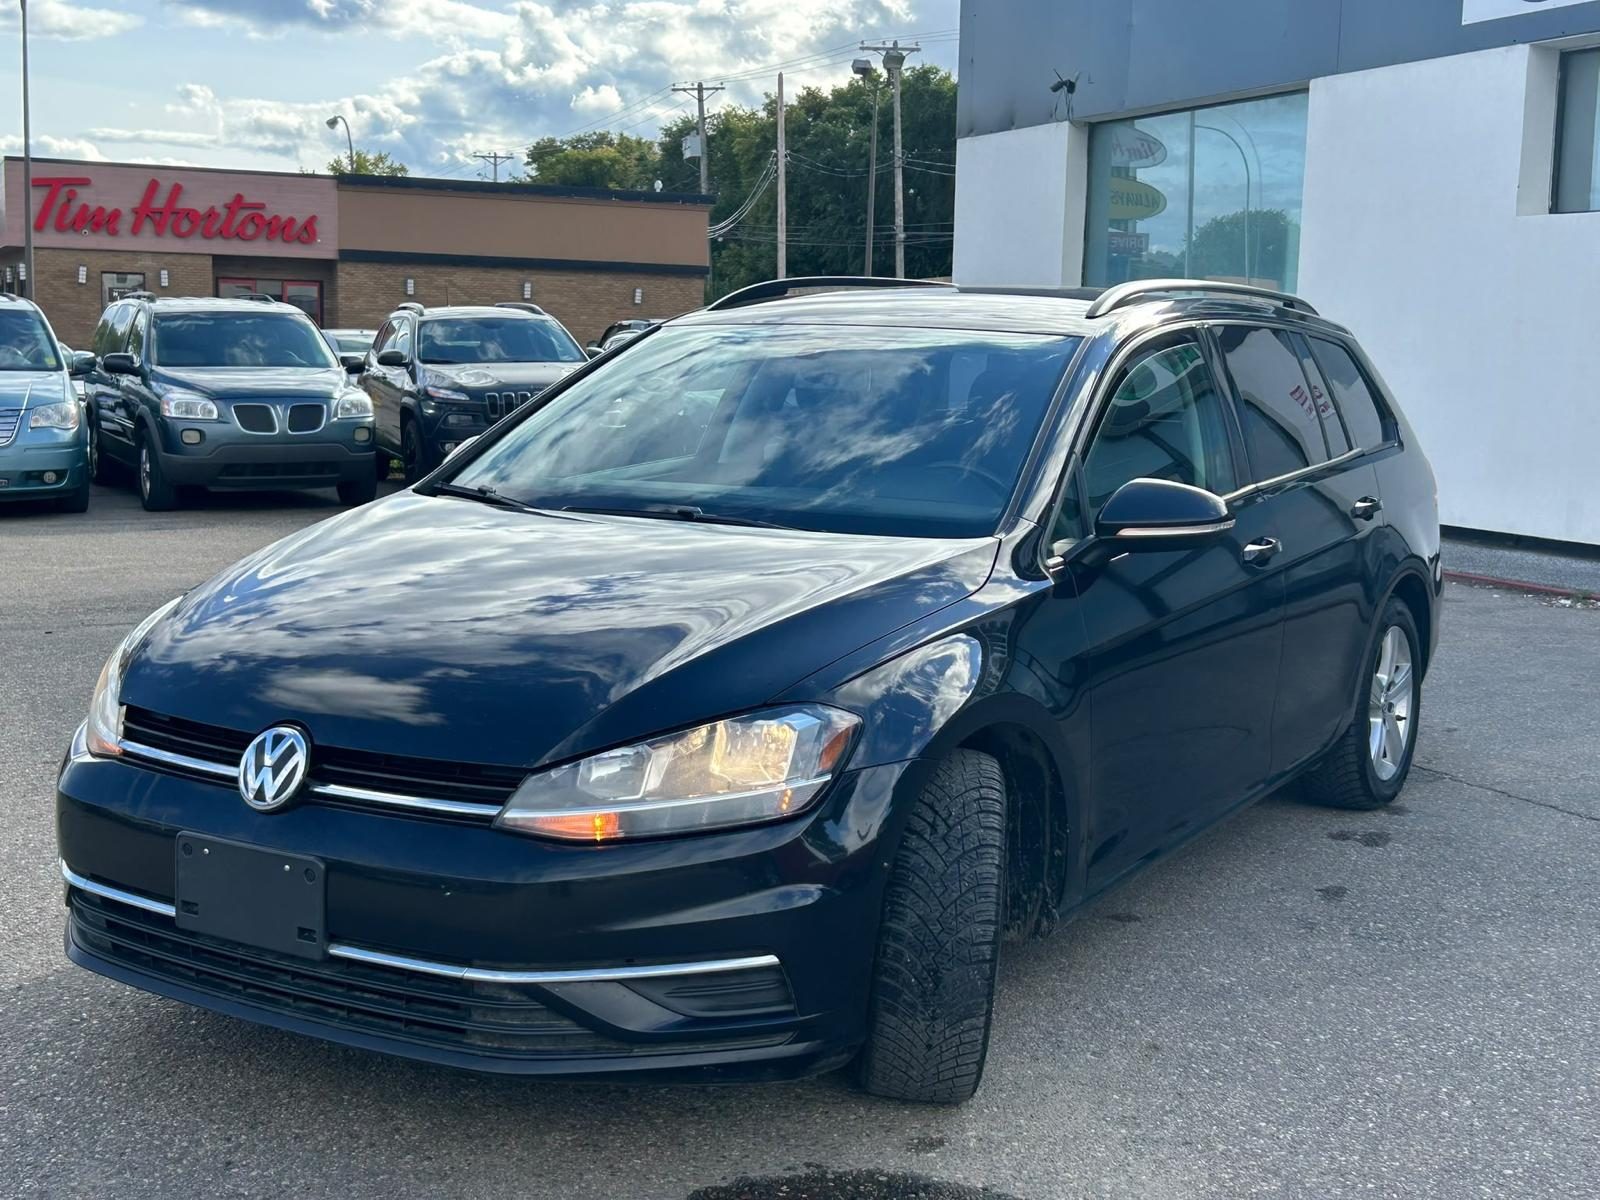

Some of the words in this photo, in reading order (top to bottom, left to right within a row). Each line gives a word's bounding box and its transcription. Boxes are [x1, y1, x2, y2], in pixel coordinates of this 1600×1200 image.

[31, 177, 121, 236] Tim
[131, 178, 318, 244] Hortons
[241, 728, 305, 808] VW
